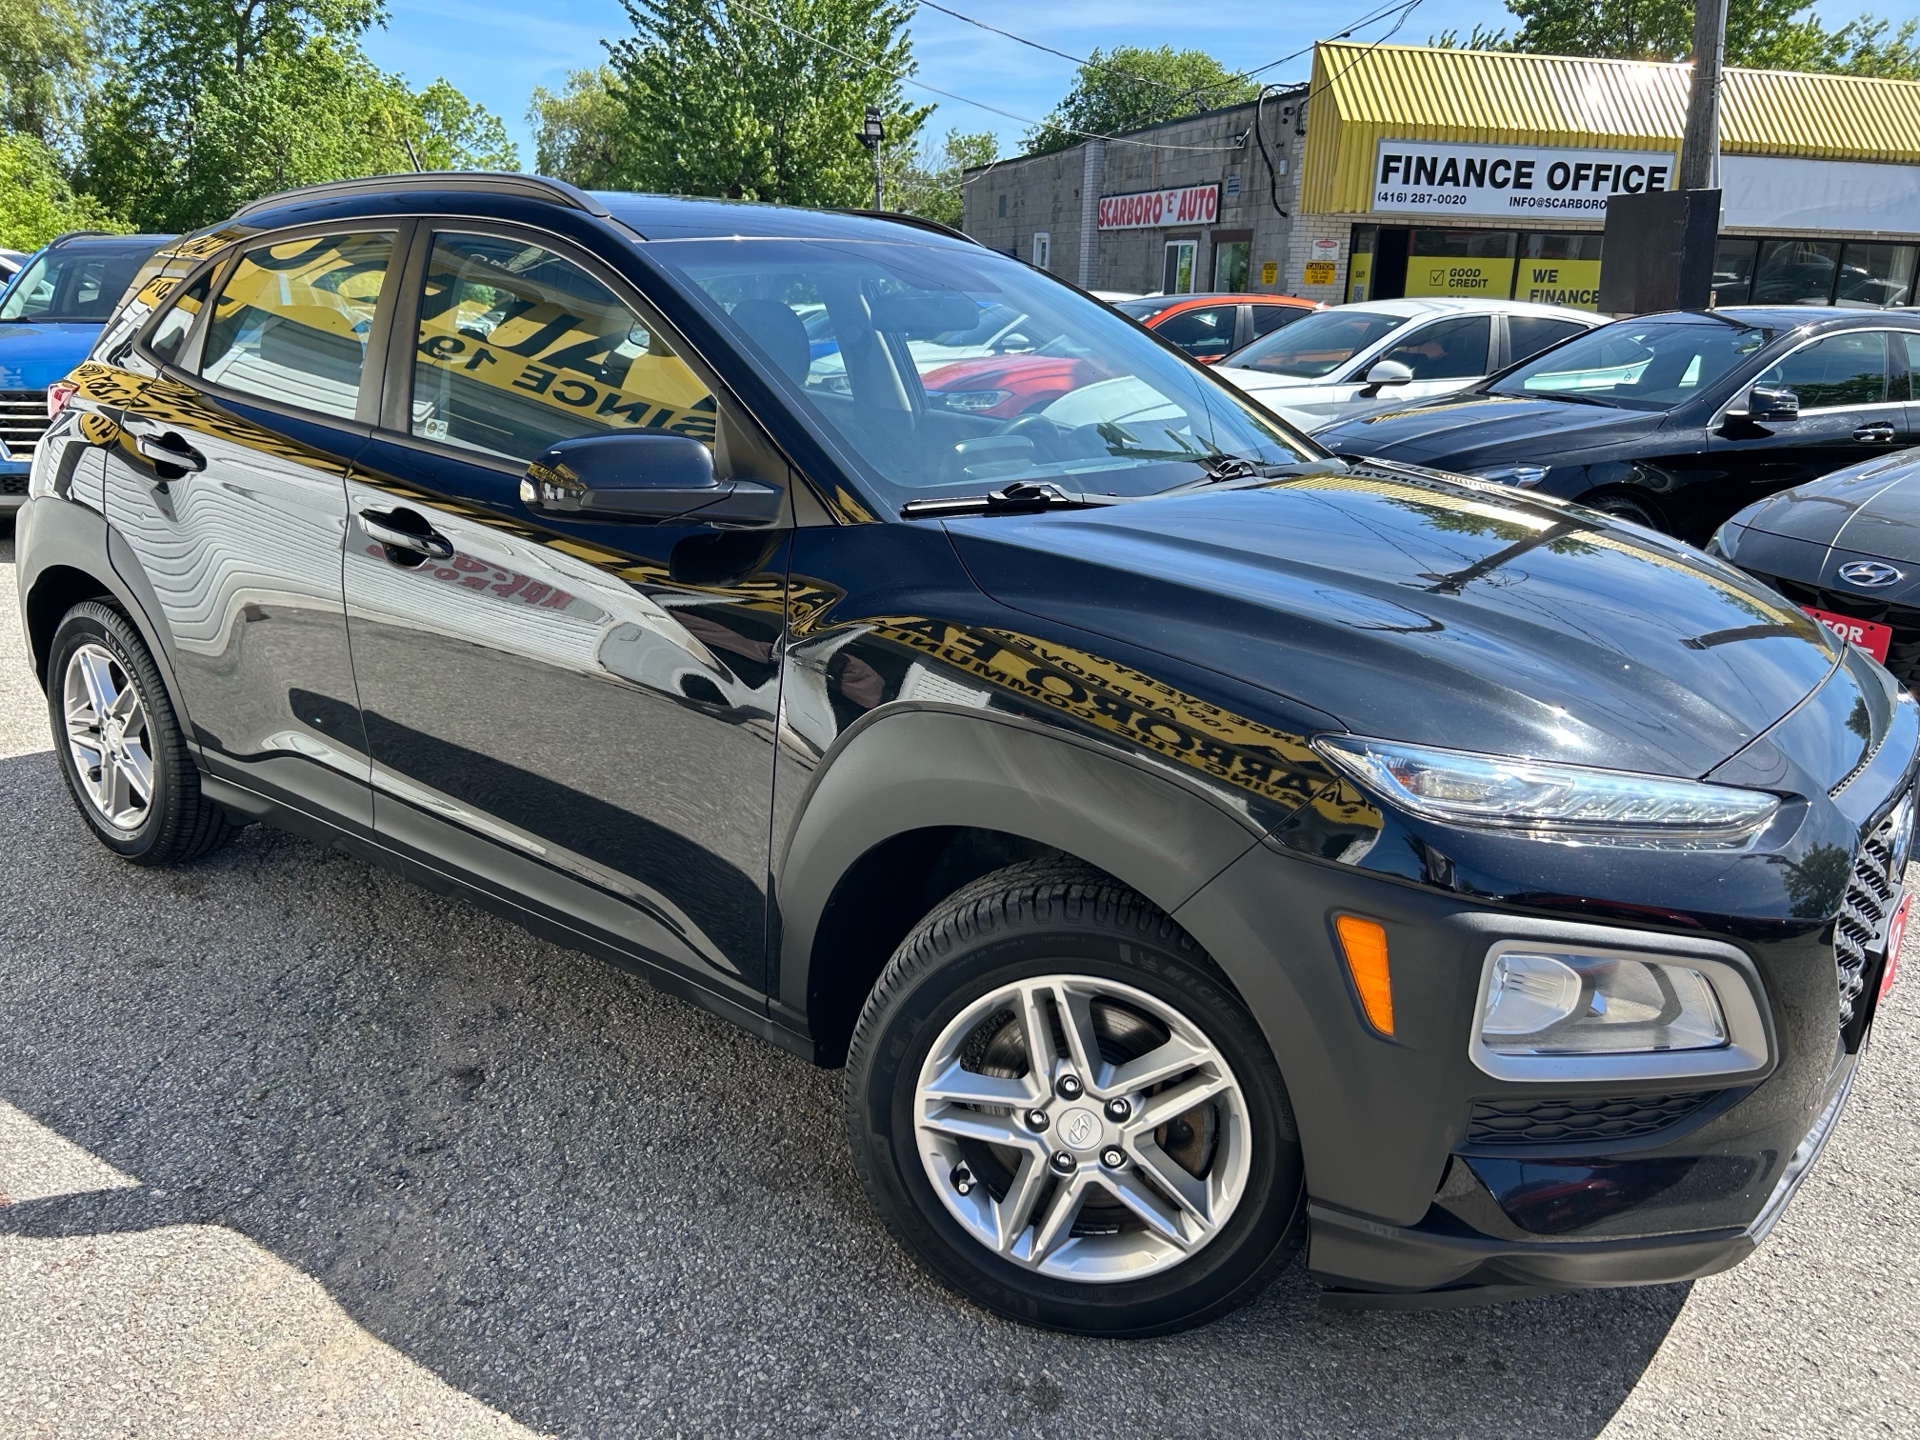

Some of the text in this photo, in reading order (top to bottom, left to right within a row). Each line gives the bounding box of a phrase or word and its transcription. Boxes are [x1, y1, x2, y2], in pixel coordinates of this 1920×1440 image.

[1380, 154, 1668, 193] FINANCE OFFICE
[1377, 191, 1467, 205] (416) 287-0020
[1509, 196, 1608, 210] INFO@SCARBORO
[1098, 193, 1163, 228] SCARBORO
[1176, 187, 1217, 222] AUTO
[1355, 270, 1366, 278] EASY
[1449, 268, 1481, 278] GOOD
[1532, 269, 1559, 284] WE
[1448, 278, 1489, 288] CREDIT
[1529, 289, 1600, 304] FINANCE
[117, 648, 150, 711] MICHELIN
